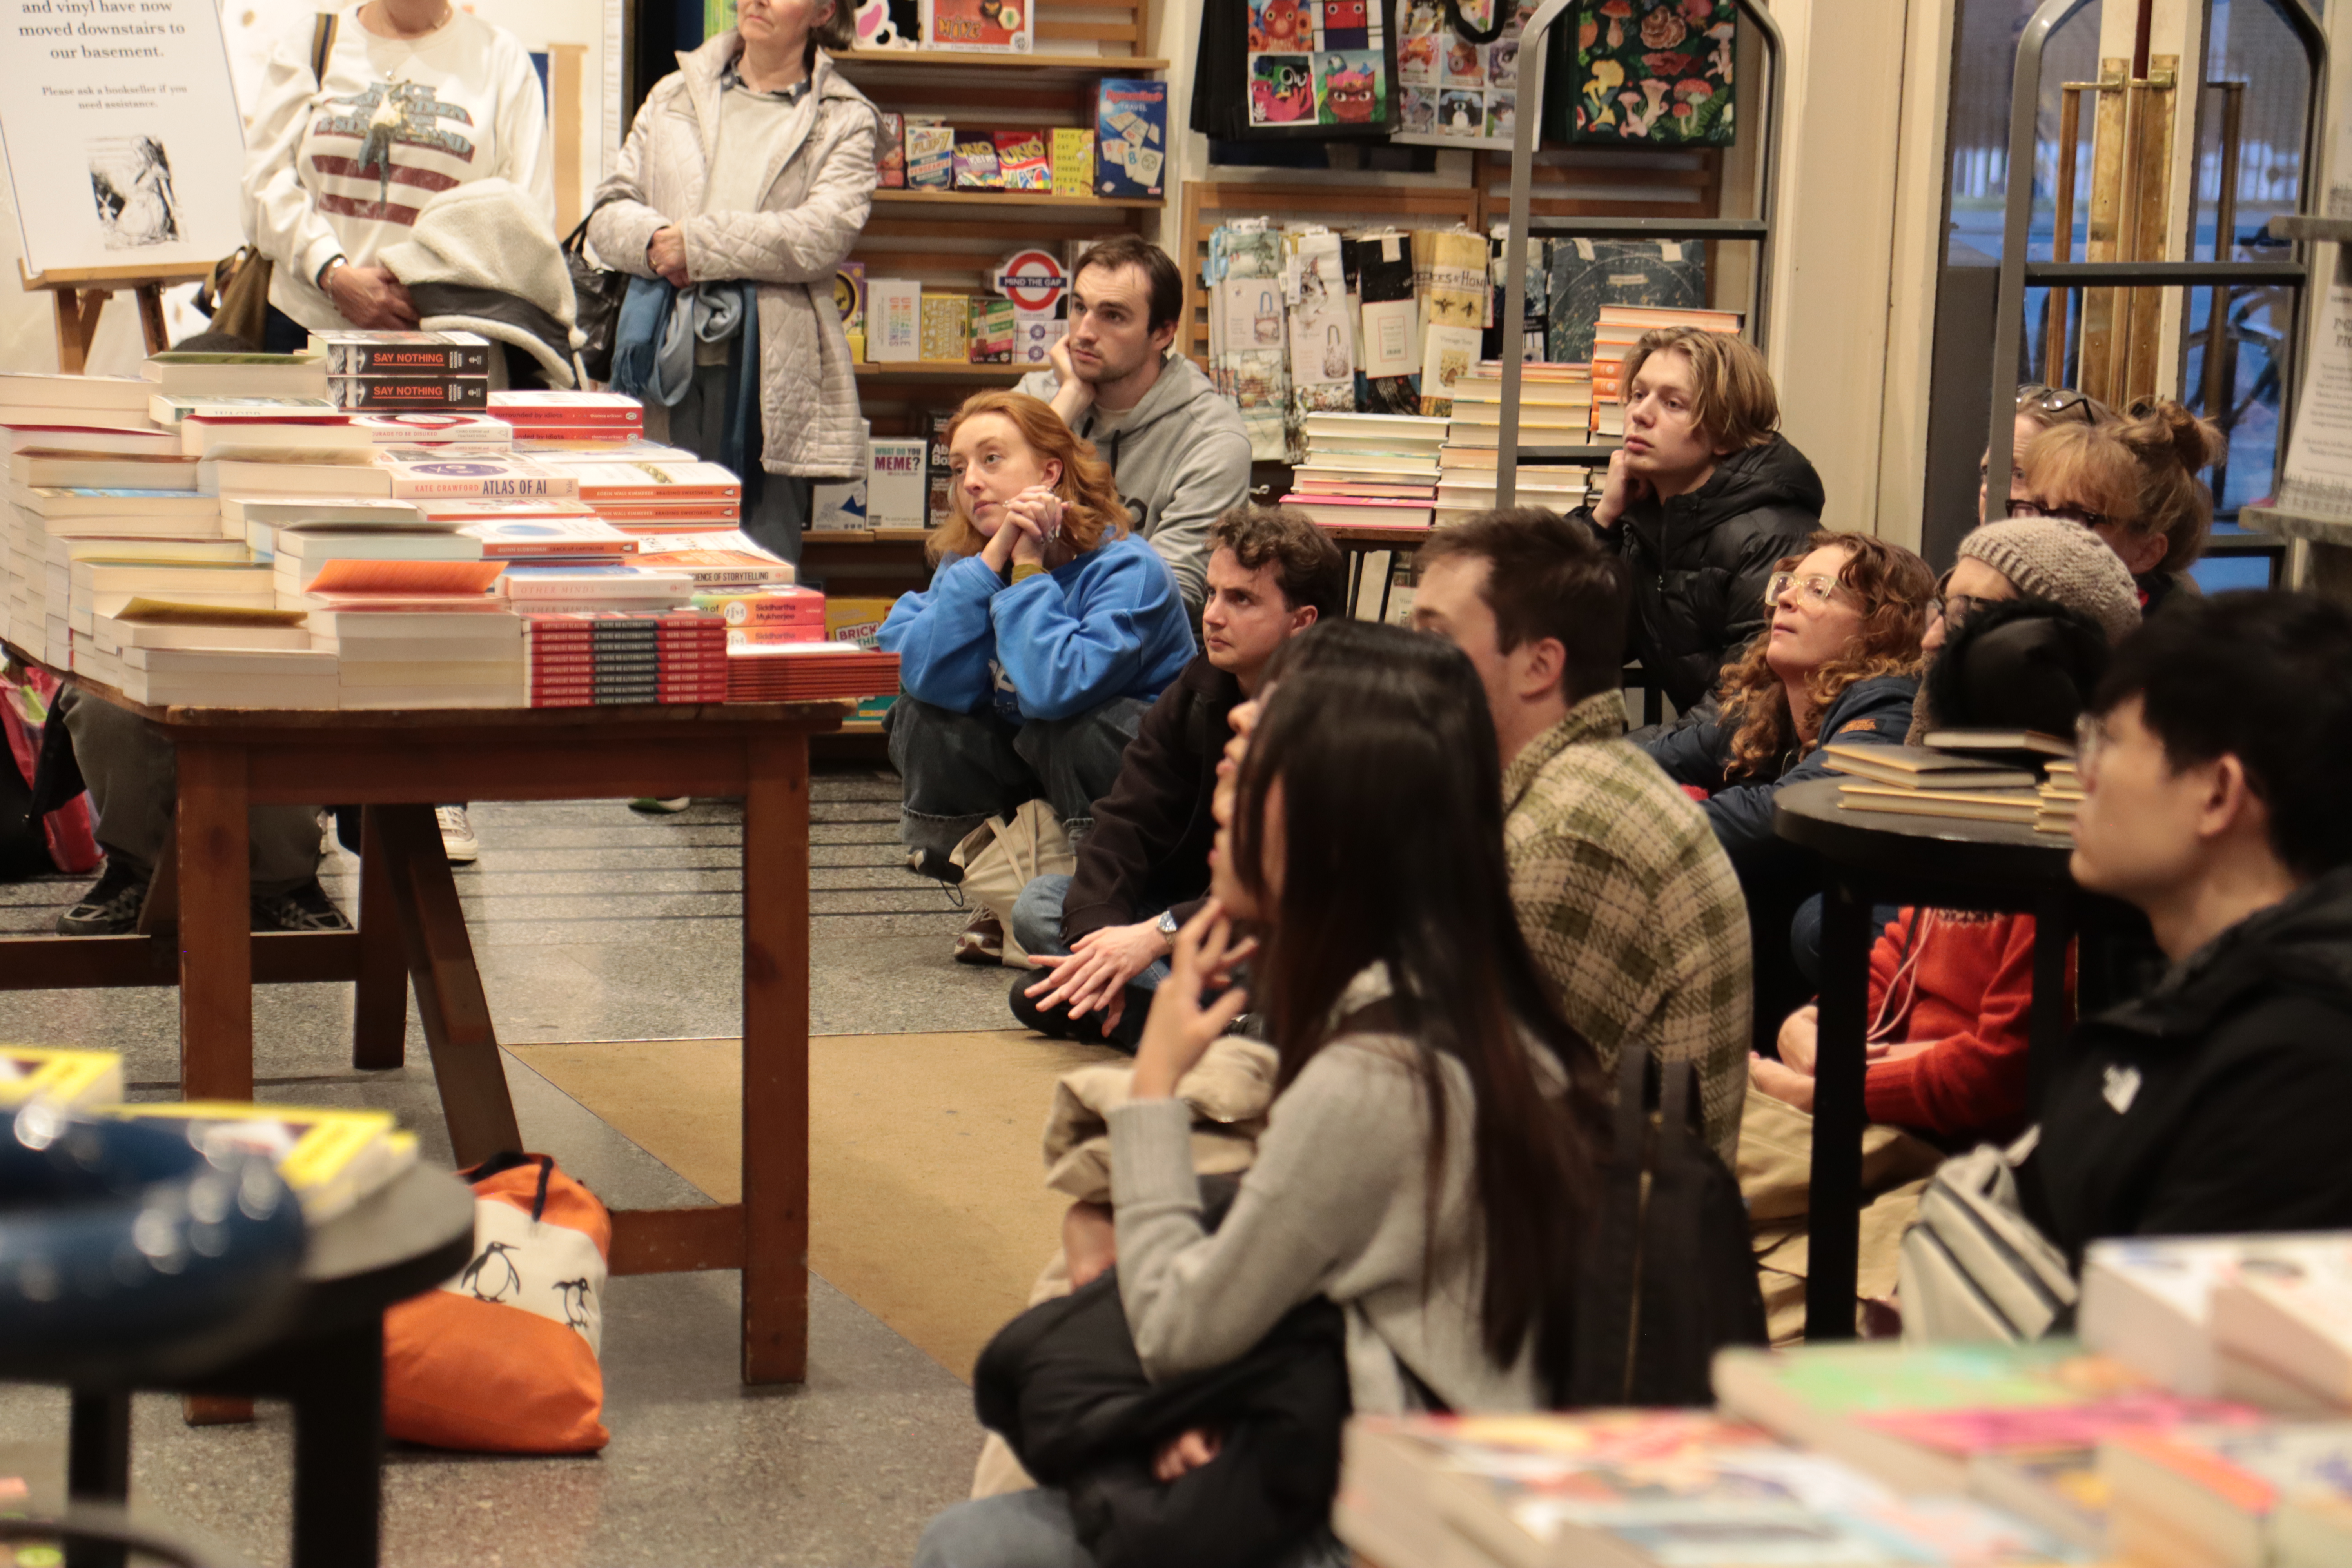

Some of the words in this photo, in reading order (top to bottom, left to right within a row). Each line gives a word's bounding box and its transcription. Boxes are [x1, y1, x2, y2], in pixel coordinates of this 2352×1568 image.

[22, 0, 51, 13] and
[57, 0, 95, 16] vinyl
[100, 0, 136, 13] have
[141, 2, 172, 12] now
[19, 23, 73, 36] moved
[78, 20, 165, 35] downstairs
[170, 23, 185, 34] to
[51, 49, 76, 59] our
[82, 44, 163, 58] basement.
[42, 87, 74, 96] Please
[78, 87, 94, 95] ask
[105, 85, 156, 94] bookseller
[159, 85, 167, 93] if
[170, 87, 187, 96] you
[78, 101, 102, 109] need
[105, 100, 158, 109] assistance.
[911, 138, 939, 155] FLIP
[939, 131, 951, 152] 7
[953, 141, 994, 158] UNO
[998, 137, 1045, 165] UNO
[1004, 278, 1026, 286] MIND
[1028, 278, 1043, 286] THE
[889, 297, 900, 347] UNICORNS
[900, 297, 911, 346] UNSTABLE
[374, 353, 394, 362] SAY
[397, 354, 443, 363] NOTHING
[374, 387, 393, 396] SAY
[396, 387, 443, 396] NOTHING
[874, 456, 920, 471] MEME?
[932, 454, 949, 465] Bo
[437, 484, 479, 492] CRAWFORD
[483, 480, 515, 494] ATLAS
[519, 480, 533, 494] OF
[536, 480, 546, 494] AI
[714, 573, 721, 581] OF
[723, 572, 768, 581] STORYTELLING
[839, 625, 877, 640] BRICK
